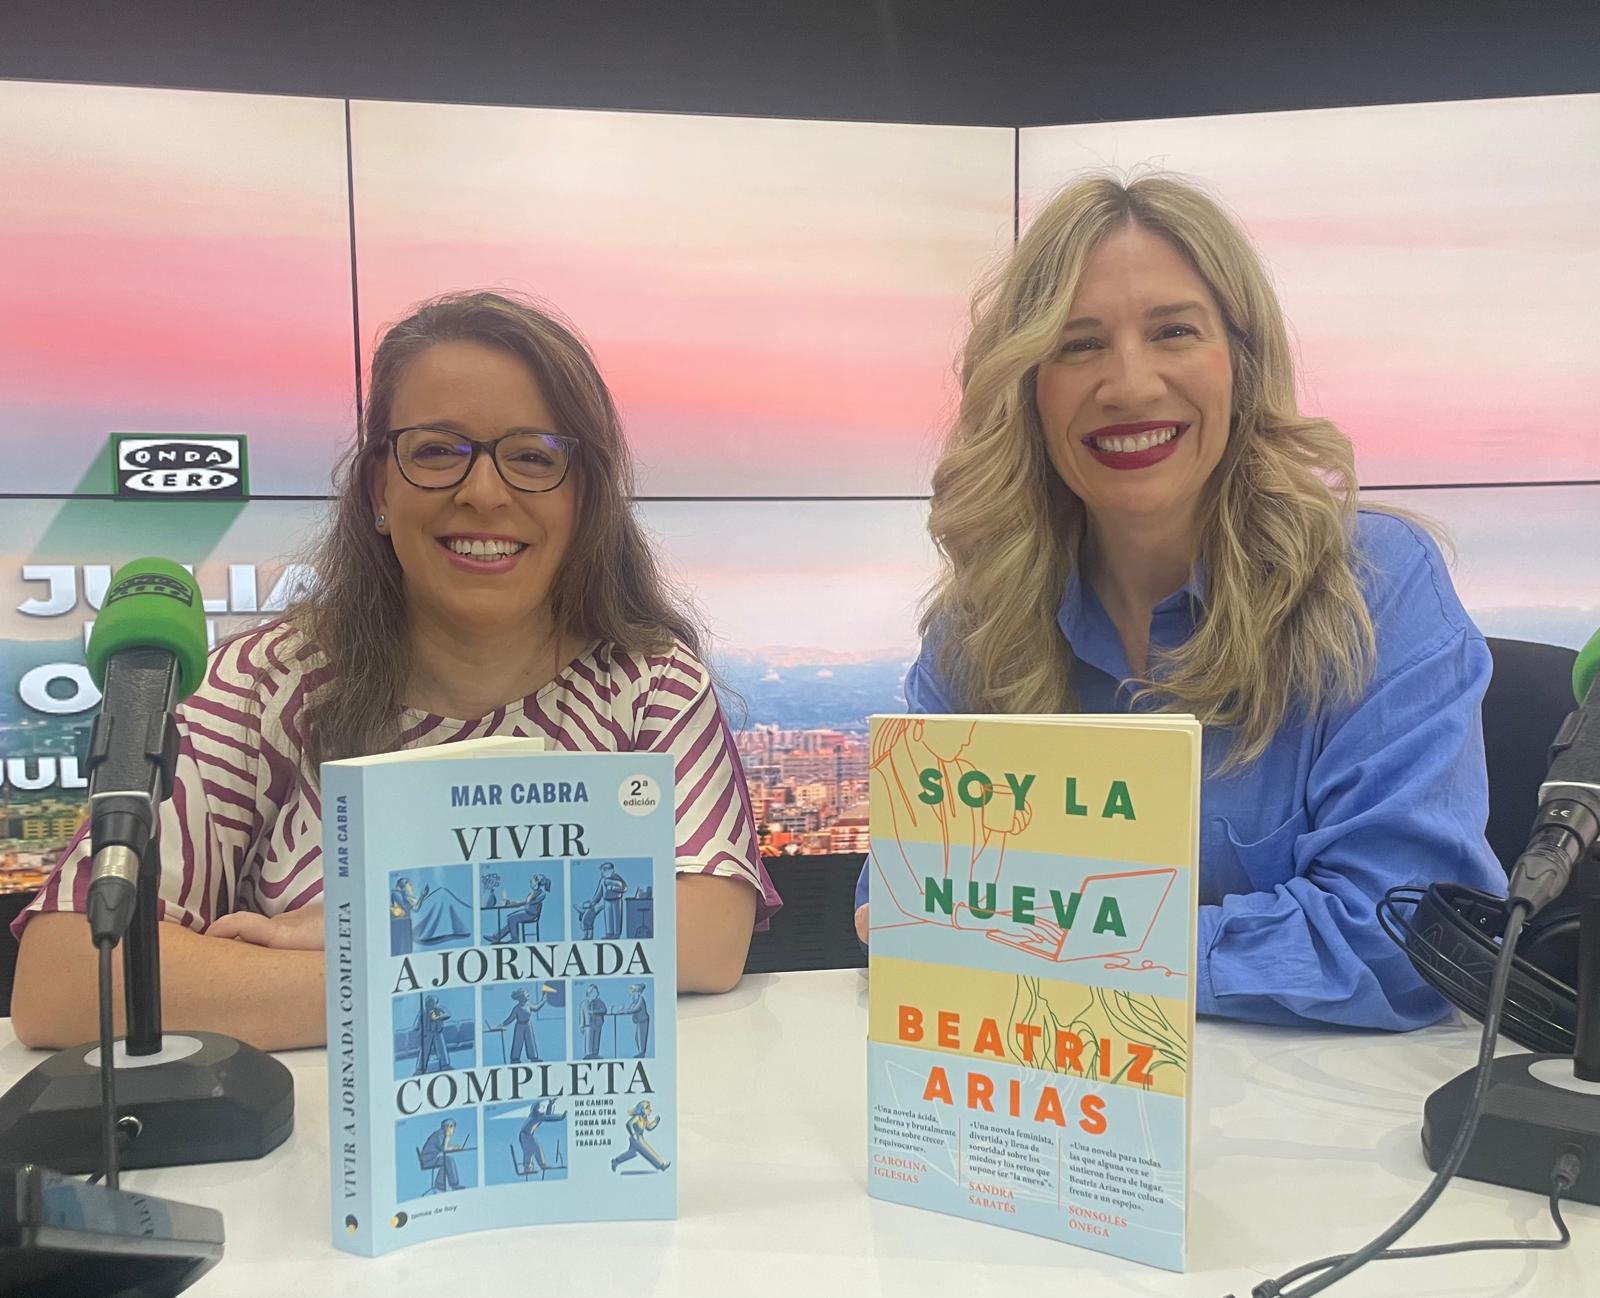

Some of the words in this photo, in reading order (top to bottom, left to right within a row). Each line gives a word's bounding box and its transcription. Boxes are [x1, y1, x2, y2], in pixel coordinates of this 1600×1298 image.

[135, 450, 222, 463] ONDA
[141, 473, 224, 487] CERO
[451, 784, 502, 807] MAR
[511, 782, 589, 805] CABRA
[630, 780, 648, 796] 2ª
[918, 768, 1036, 811] SOY
[1065, 777, 1136, 821] LA
[623, 796, 656, 807] edición
[336, 795, 348, 842] CABRA
[451, 823, 590, 861] VIVIR
[338, 846, 349, 877] MAR
[925, 877, 1127, 937] NUEVA
[339, 902, 353, 1012] COMPLETA
[392, 956, 423, 994] A
[431, 941, 655, 987] JORNADA
[899, 1005, 1153, 1086] BEATRIZ
[341, 1020, 355, 1117] JORNADA
[395, 1060, 655, 1116] COMPLETA
[922, 1065, 1108, 1135] ARIAS
[575, 1109, 596, 1117] HACIA
[575, 1119, 599, 1127] FORMA
[893, 1108, 915, 1119] novela
[917, 1113, 939, 1123] ácida,
[344, 1123, 355, 1136] A
[874, 1115, 904, 1127] moderna
[911, 1121, 956, 1137] brutalmente
[874, 1124, 900, 1137] honesta
[901, 1131, 921, 1141] sobre
[922, 1136, 945, 1146] crecer
[990, 1125, 1015, 1136] novela
[1016, 1129, 1054, 1145] feminista,
[969, 1131, 1003, 1145] divertida
[1010, 1139, 1029, 1150] llena
[1030, 1144, 1039, 1153] de
[873, 1153, 928, 1173] CAROLINA
[969, 1144, 1005, 1156] sororidad
[1007, 1150, 1027, 1161] sobre
[1029, 1154, 1040, 1164] los
[1069, 1151, 1080, 1161] las
[1082, 1156, 1096, 1165] que
[1097, 1159, 1124, 1172] alguna
[1125, 1166, 1139, 1175] vez
[1140, 1169, 1150, 1178] se
[1091, 1147, 1117, 1159] novela
[1118, 1153, 1137, 1163] para
[1138, 1156, 1162, 1169] todas
[344, 1142, 356, 1199] VIVIR
[873, 1167, 920, 1184] IGLESIAS
[969, 1154, 996, 1165] miedos
[1003, 1159, 1014, 1168] los
[1016, 1164, 1035, 1174] retos
[1036, 1168, 1050, 1177] que
[969, 1165, 996, 1176] supone
[997, 1170, 1008, 1178] ser
[1069, 1164, 1104, 1178] sintieron
[1106, 1172, 1127, 1184] fuera
[1128, 1177, 1138, 1187] de
[969, 1182, 1015, 1200] SANDRA
[1069, 1175, 1097, 1189] Beatriz
[1098, 1182, 1120, 1193] Arias
[1121, 1189, 1136, 1198] nos
[1137, 1192, 1164, 1205] coloca
[1069, 1186, 1092, 1199] frente
[1100, 1195, 1110, 1204] un
[1068, 1205, 1128, 1228] SONSOLES
